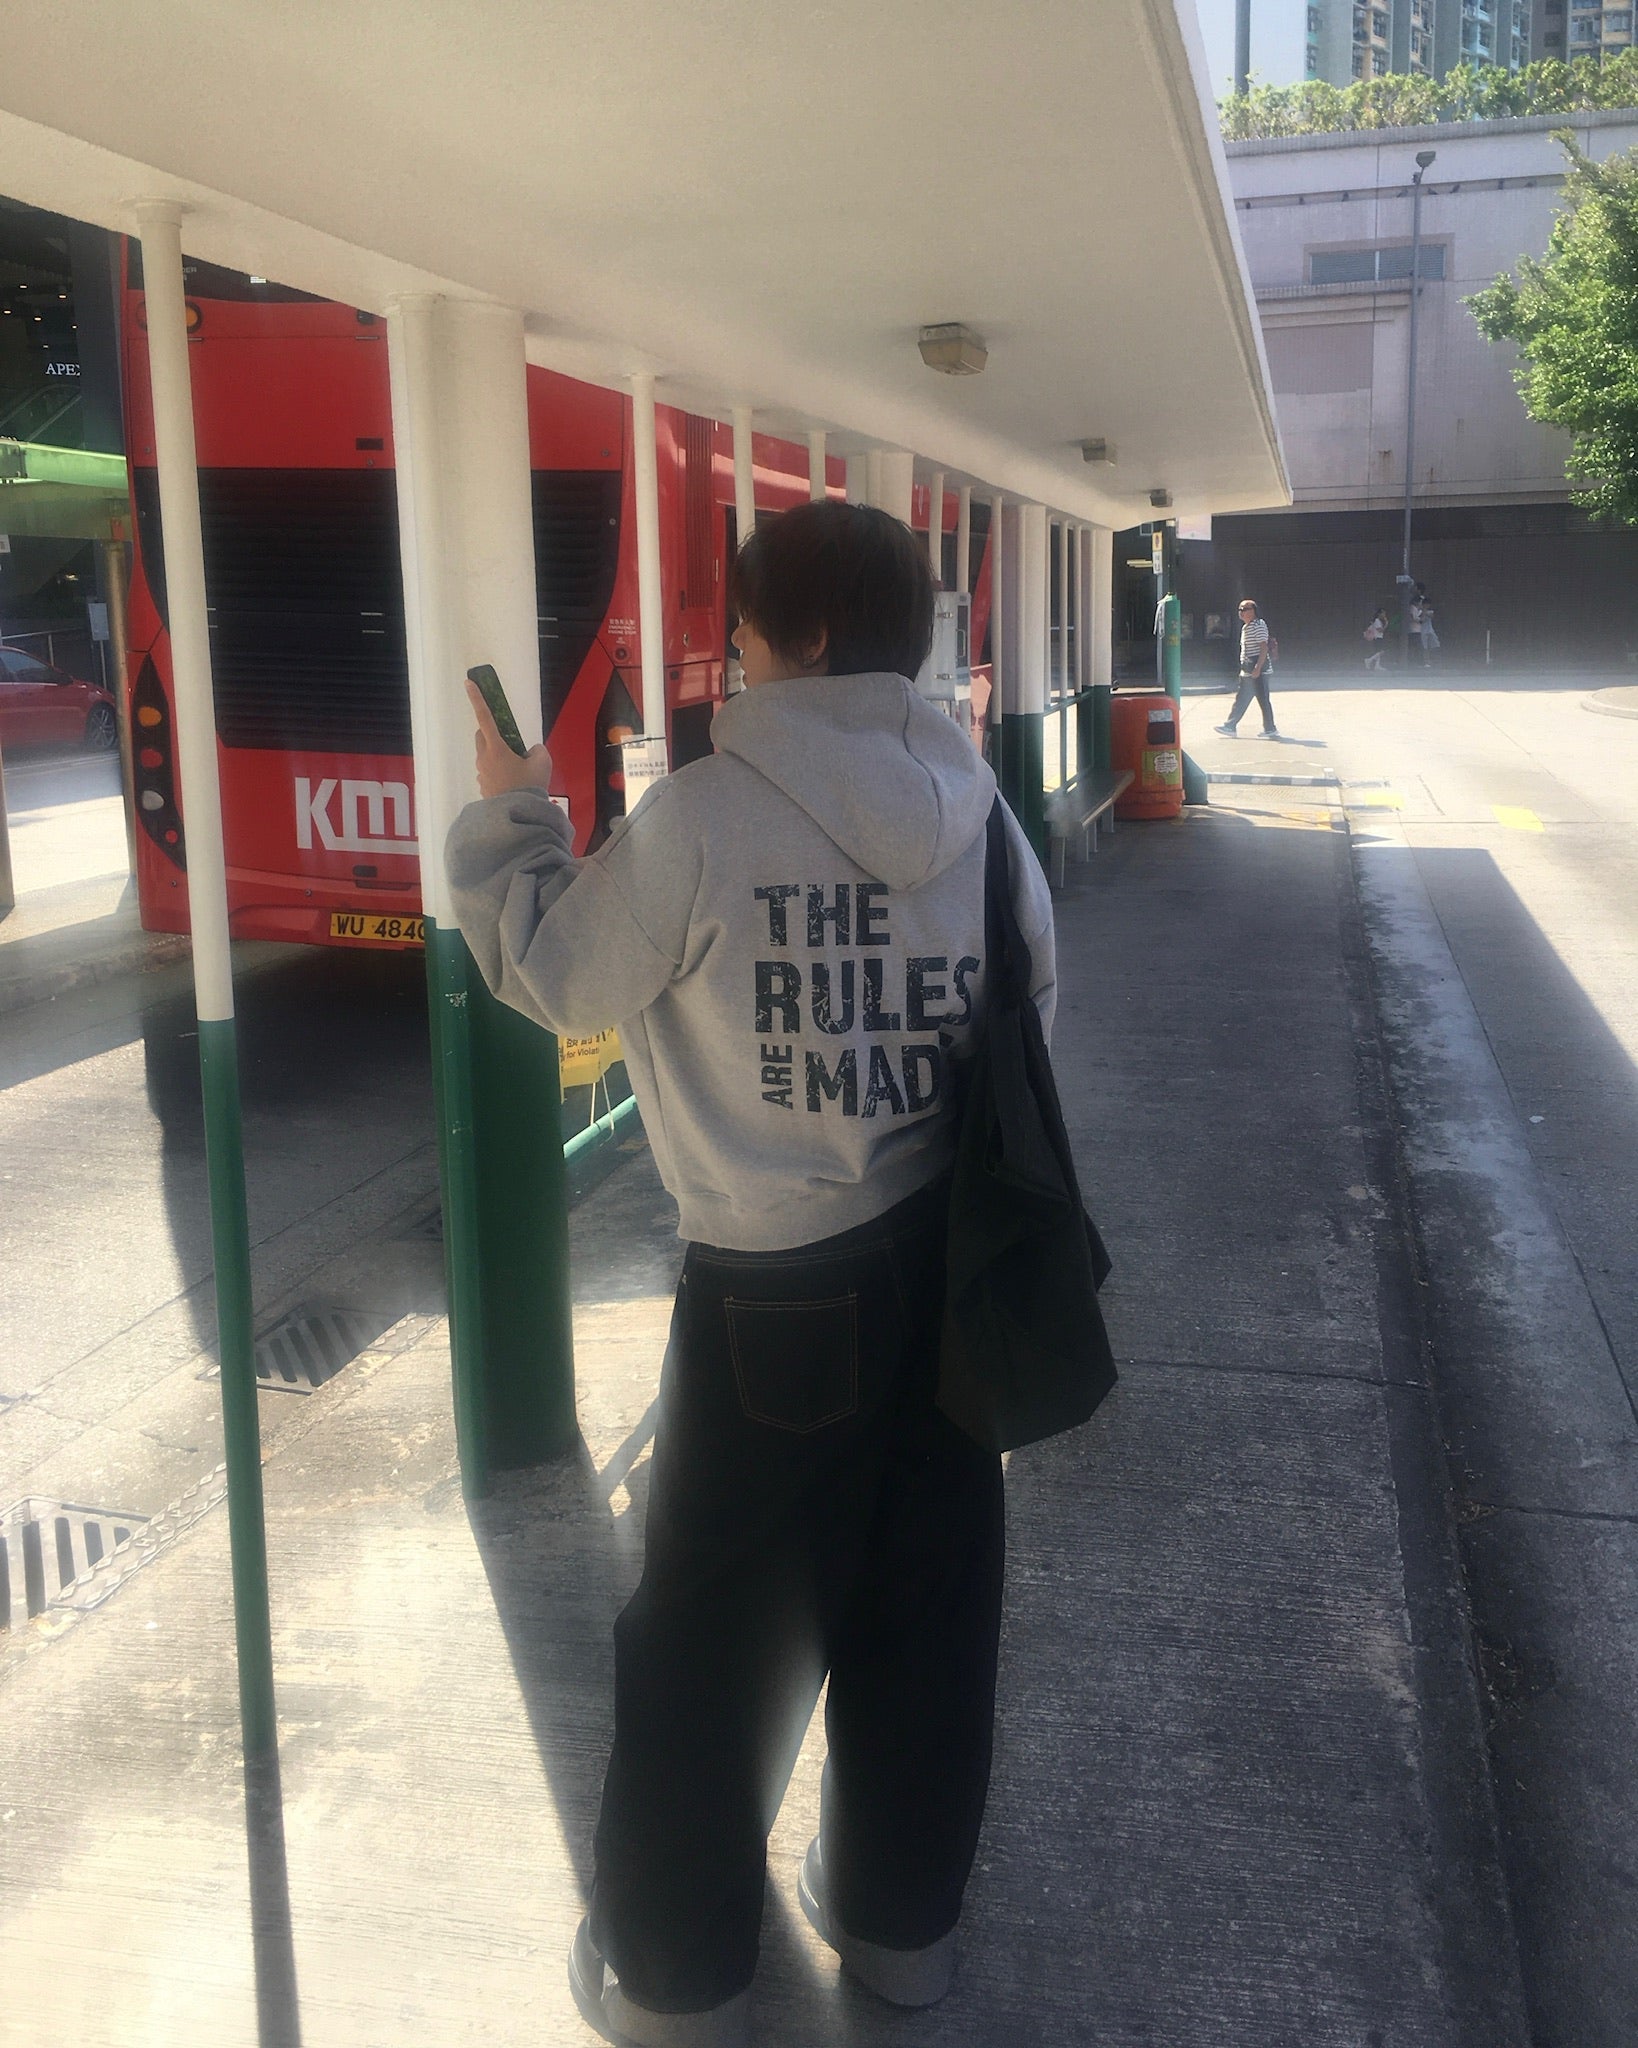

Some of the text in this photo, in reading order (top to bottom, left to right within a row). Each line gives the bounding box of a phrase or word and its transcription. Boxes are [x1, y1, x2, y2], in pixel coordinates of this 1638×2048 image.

[337, 915, 364, 937] WU
[754, 883, 890, 947] THE
[755, 956, 980, 1034] RULES
[761, 1043, 794, 1110] ARE
[805, 1042, 946, 1118] MAD
